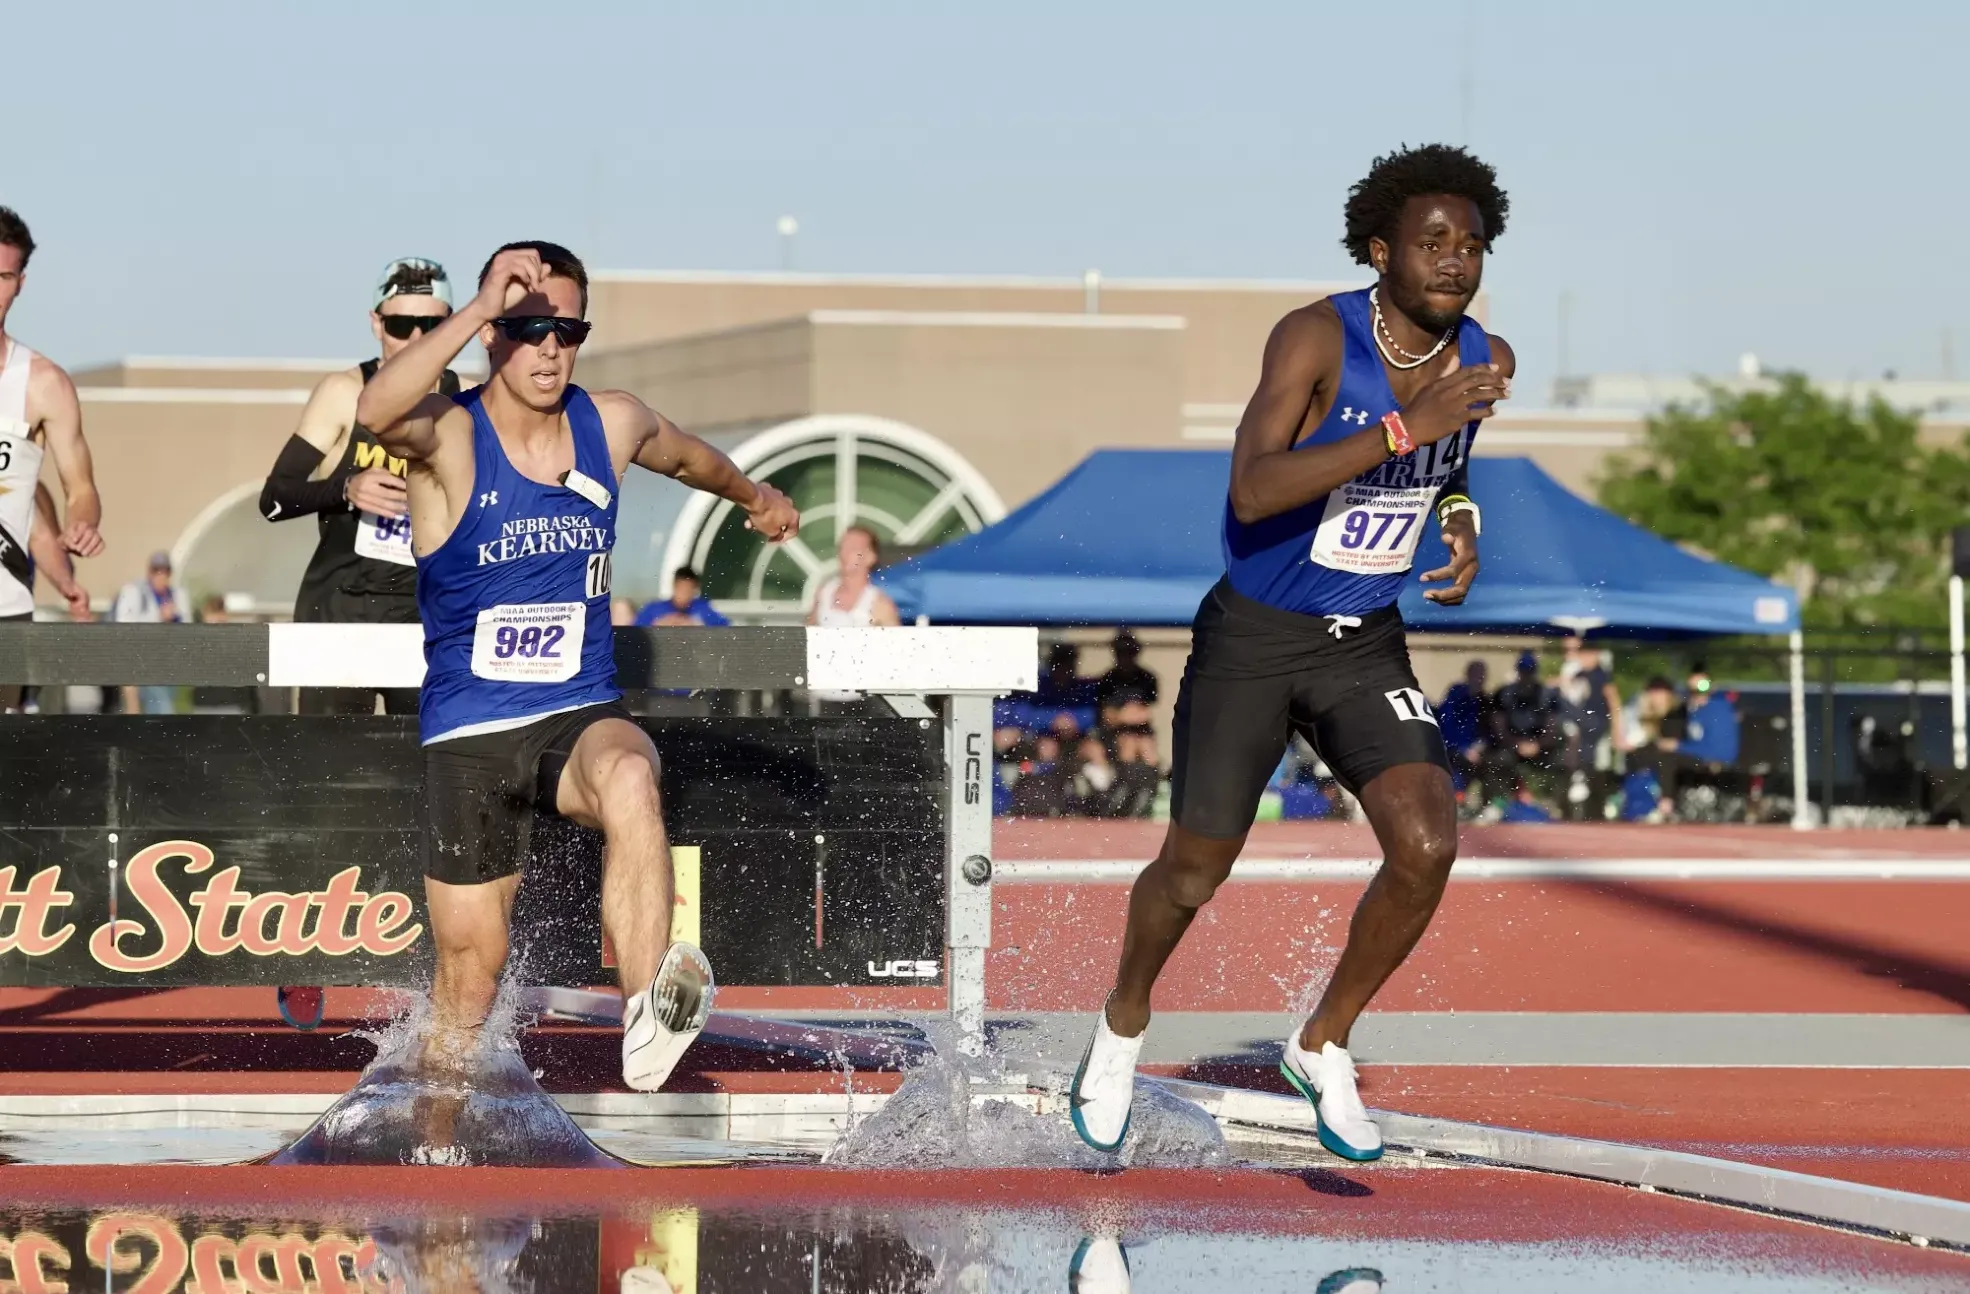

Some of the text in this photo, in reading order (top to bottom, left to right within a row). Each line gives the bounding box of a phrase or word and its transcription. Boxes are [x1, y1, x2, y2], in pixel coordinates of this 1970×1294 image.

[0, 441, 12, 471] 6
[1425, 431, 1460, 476] 14
[1345, 497, 1426, 508] CHAMPIONSHIPS
[1355, 487, 1421, 498] MIAA OUTDOOR
[502, 515, 592, 538] NEBRASKA
[1340, 510, 1418, 550] 977
[477, 528, 608, 566] KEARNEY
[1332, 550, 1360, 559] HOSTED
[1336, 558, 1400, 568] STATE UNIVERSITY
[493, 614, 572, 623] CHAMPIONSHIPS
[499, 606, 566, 615] MIAA OUTDOOR
[494, 625, 566, 658] 992
[965, 733, 981, 805] UCS
[88, 840, 423, 972] State
[868, 960, 938, 977] UCS
